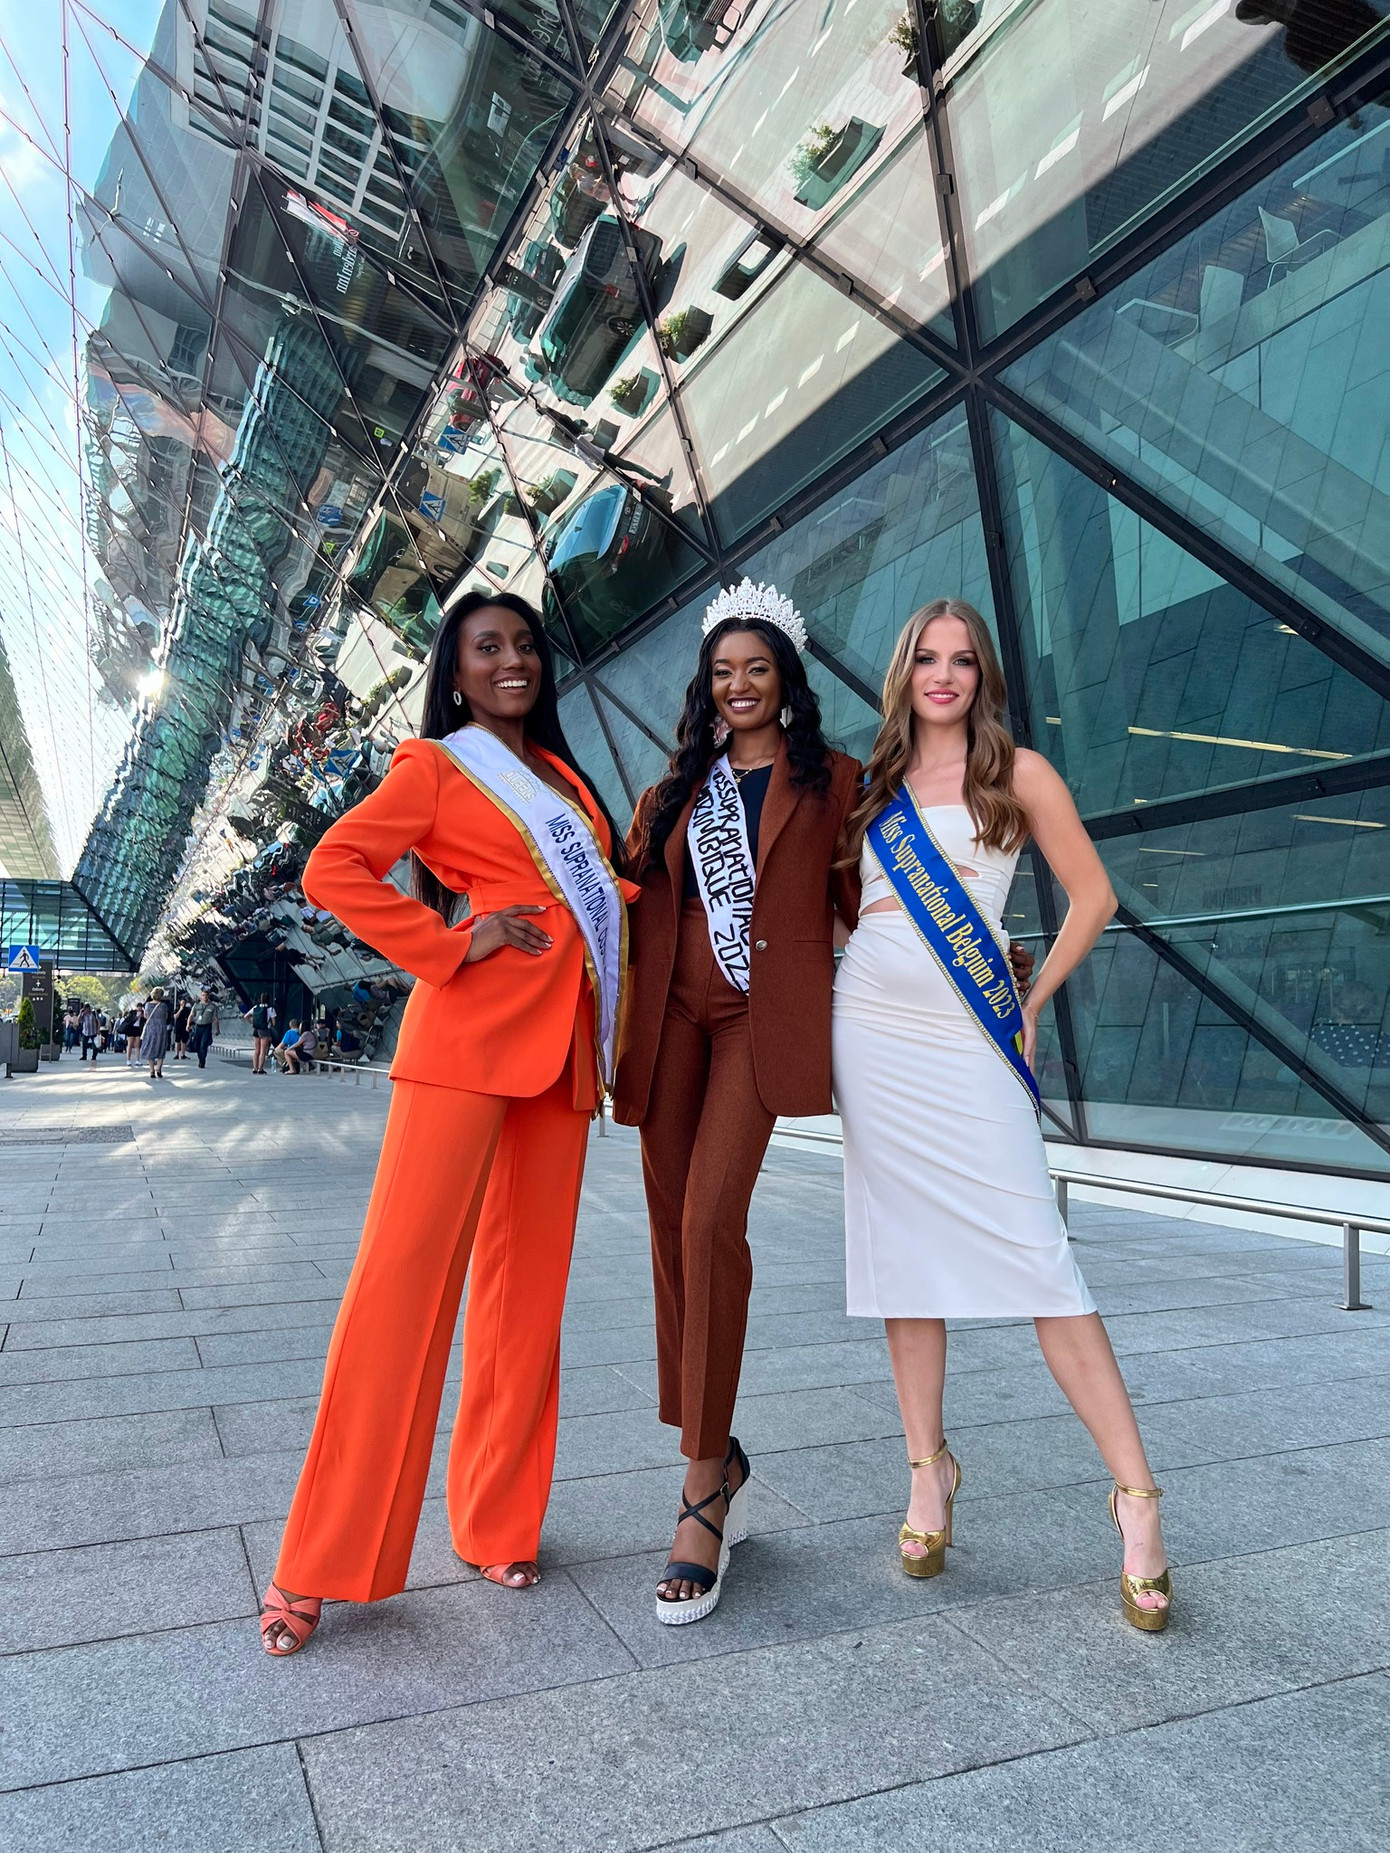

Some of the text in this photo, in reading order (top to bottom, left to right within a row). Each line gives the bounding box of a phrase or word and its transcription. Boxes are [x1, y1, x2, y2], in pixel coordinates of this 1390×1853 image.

[544, 813, 576, 844] MISS
[560, 841, 609, 933] SUPRANATIONAL
[878, 810, 1016, 1019] Miss Supranational Belgium 2023
